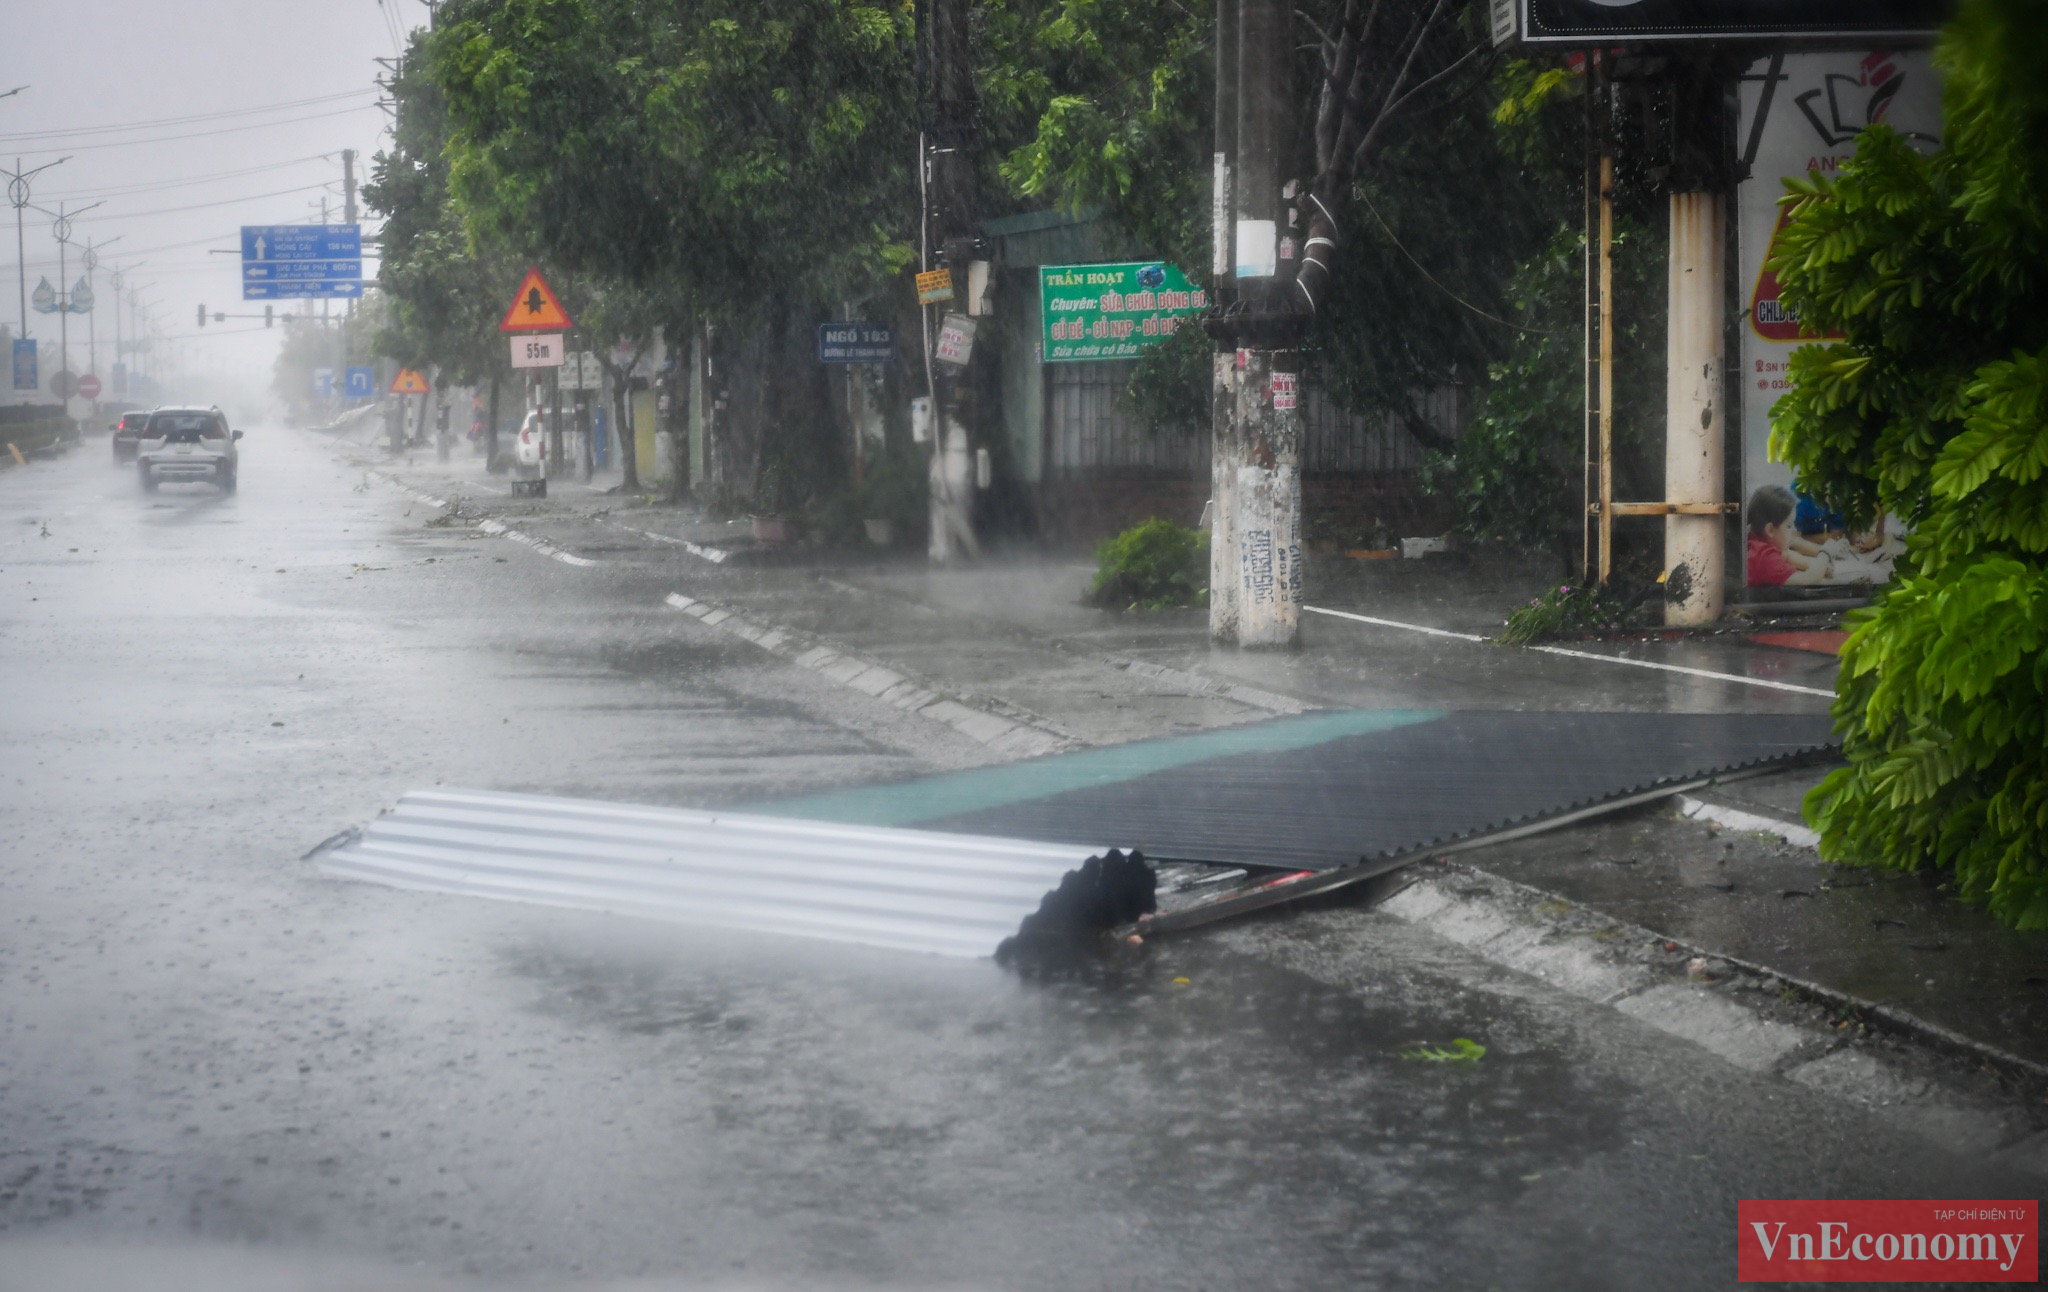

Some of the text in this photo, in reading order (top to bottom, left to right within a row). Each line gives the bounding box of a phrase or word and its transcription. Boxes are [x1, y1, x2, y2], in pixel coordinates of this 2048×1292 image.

[1087, 271, 1125, 287] HOẠT
[1050, 296, 1098, 312] Chuyên:
[1158, 288, 1189, 313] ĐỘNG
[1111, 319, 1134, 341] NẠP
[527, 342, 550, 359] 55m
[1102, 343, 1115, 355] có
[1117, 342, 1138, 354] Bảo
[1766, 363, 1778, 372] SN
